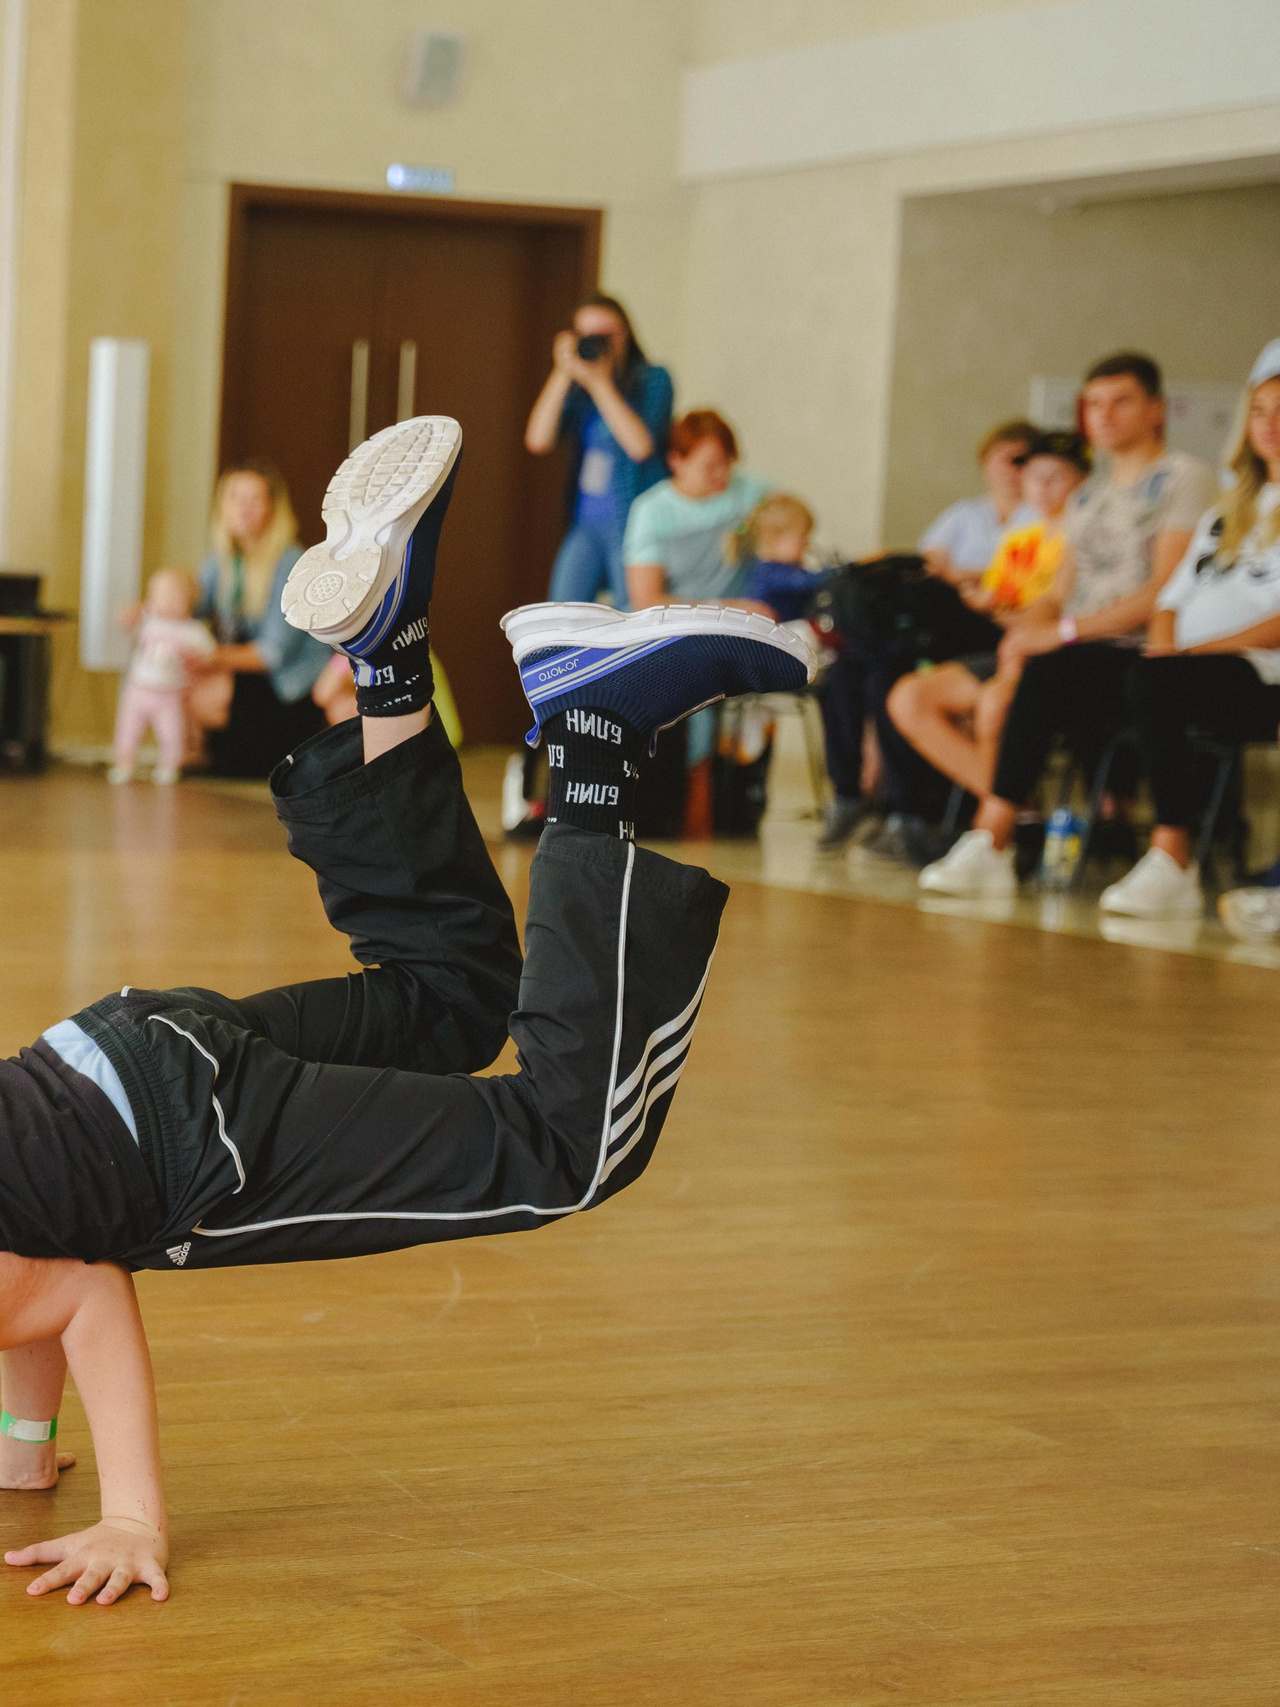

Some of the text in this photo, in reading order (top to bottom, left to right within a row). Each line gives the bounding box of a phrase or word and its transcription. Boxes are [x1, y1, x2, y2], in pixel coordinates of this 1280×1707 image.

[539, 659, 579, 681] JOMOTO
[566, 709, 622, 745] БЛИН
[565, 781, 619, 805] БЛИН
